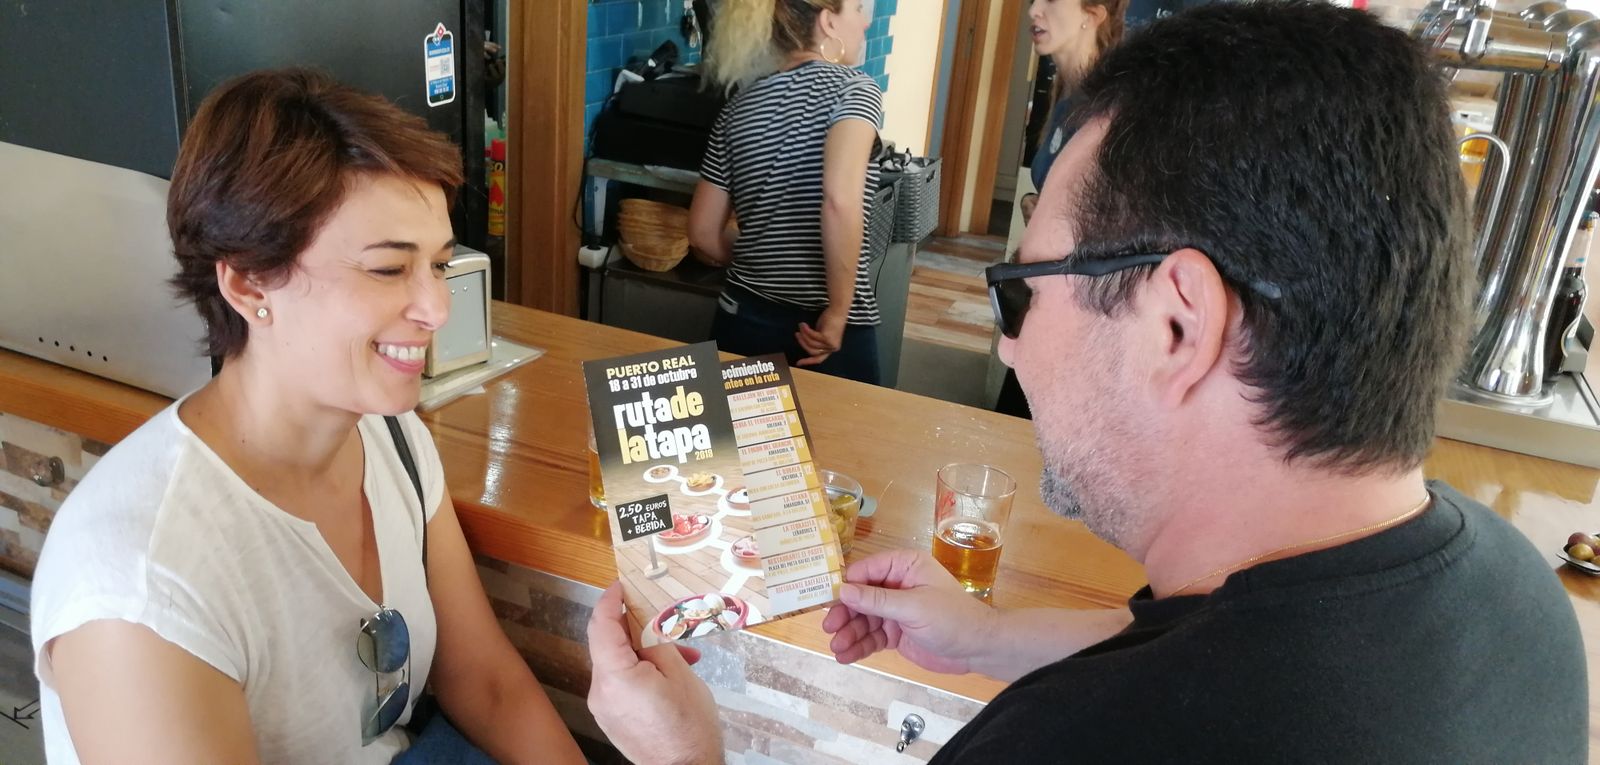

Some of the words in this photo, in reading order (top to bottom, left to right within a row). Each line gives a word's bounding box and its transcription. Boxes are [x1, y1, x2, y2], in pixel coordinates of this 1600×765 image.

[606, 361, 659, 379] PUERTO
[662, 355, 695, 369] REAL
[609, 379, 620, 392] 18
[622, 380, 629, 389] a
[630, 376, 642, 389] 31
[643, 375, 656, 387] de
[658, 368, 697, 384] octubre
[744, 376, 755, 386] en
[754, 374, 763, 384] la
[763, 371, 780, 382] ruta
[619, 504, 642, 519] 2,50
[646, 500, 667, 511] EUROS
[632, 511, 658, 524] TAPA
[635, 519, 666, 534] BEBIDA
